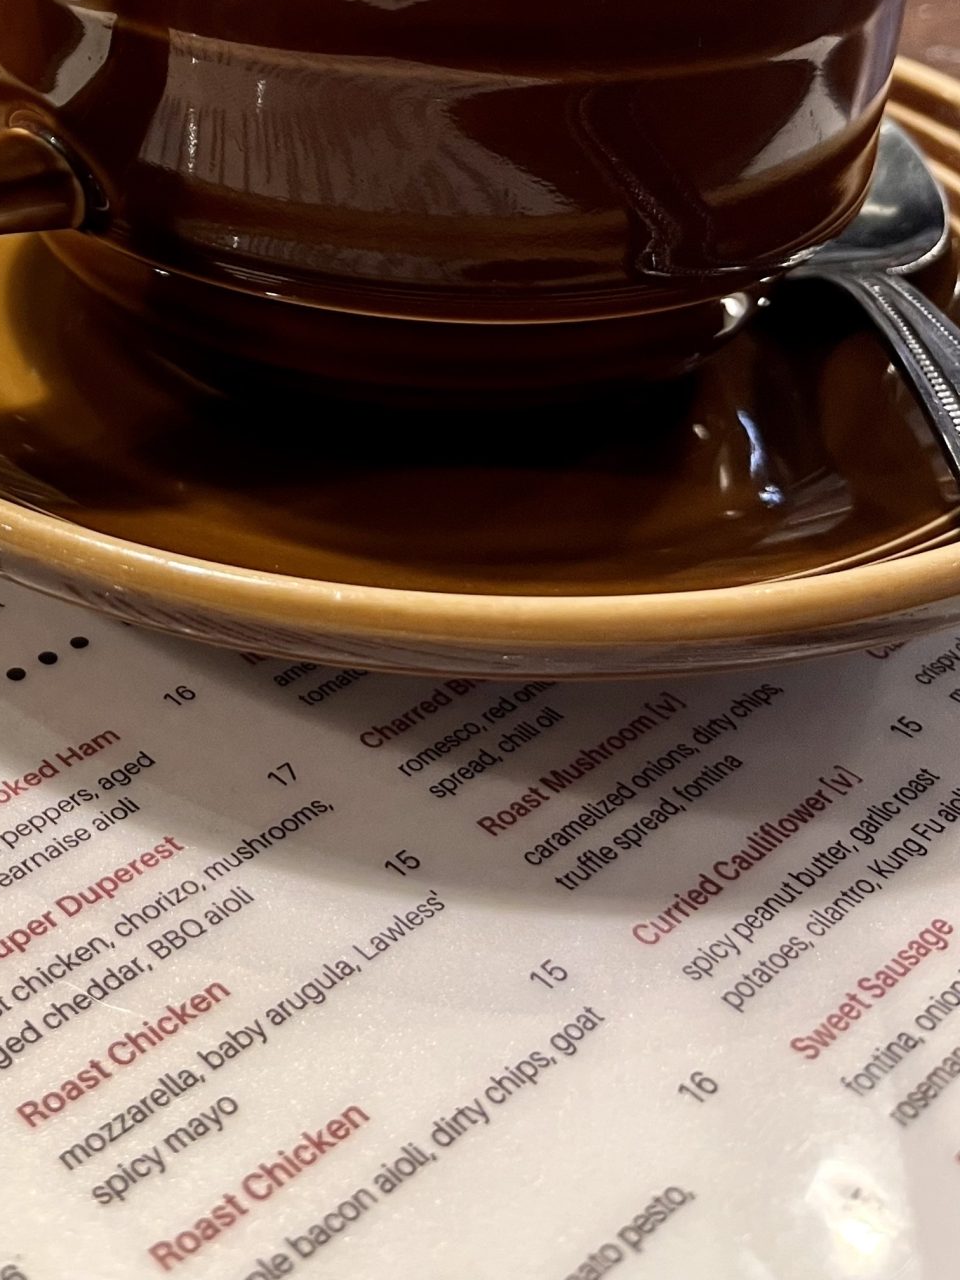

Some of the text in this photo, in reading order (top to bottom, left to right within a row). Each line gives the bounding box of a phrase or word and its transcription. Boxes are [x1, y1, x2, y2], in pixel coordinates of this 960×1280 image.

[56, 728, 121, 768] Ham
[163, 685, 196, 706] 16
[360, 689, 453, 749] Charred
[398, 696, 517, 777] romesco, red
[890, 716, 923, 738] 15
[0, 786, 100, 850] peppers,
[97, 751, 156, 790] aged
[92, 796, 141, 833] aioli
[267, 762, 298, 787] 17
[429, 748, 504, 799] spread,
[476, 691, 687, 836] Roast Mushroom [v]
[523, 713, 738, 866] caramelized onions, dirty
[55, 834, 185, 918] Duperest
[384, 848, 421, 877] 15
[555, 752, 743, 890] truffle spread, fontina
[632, 765, 863, 945] Curried Cauliflower [v]
[682, 768, 940, 981] spicy peanut butter, garlic roast
[11, 935, 116, 1003] chicken,
[113, 879, 207, 938] chorizo,
[203, 797, 334, 881] mushrooms,
[721, 818, 945, 1013] potatoes, cilantro, Kung Fu
[42, 957, 153, 1031] cheddar,
[146, 918, 207, 960] BBQ
[204, 886, 255, 925] aioli
[530, 958, 568, 989] 15
[790, 918, 954, 1061] Sweet Sausage
[17, 981, 232, 1129] Roast Chicken
[59, 959, 362, 1171] mozzarella, baby arugula,
[677, 1071, 719, 1104] 16
[92, 1094, 239, 1205] spicy mayo
[148, 1104, 371, 1271] Roast Chicken
[284, 1005, 605, 1259] bacon dirty chips, goat
